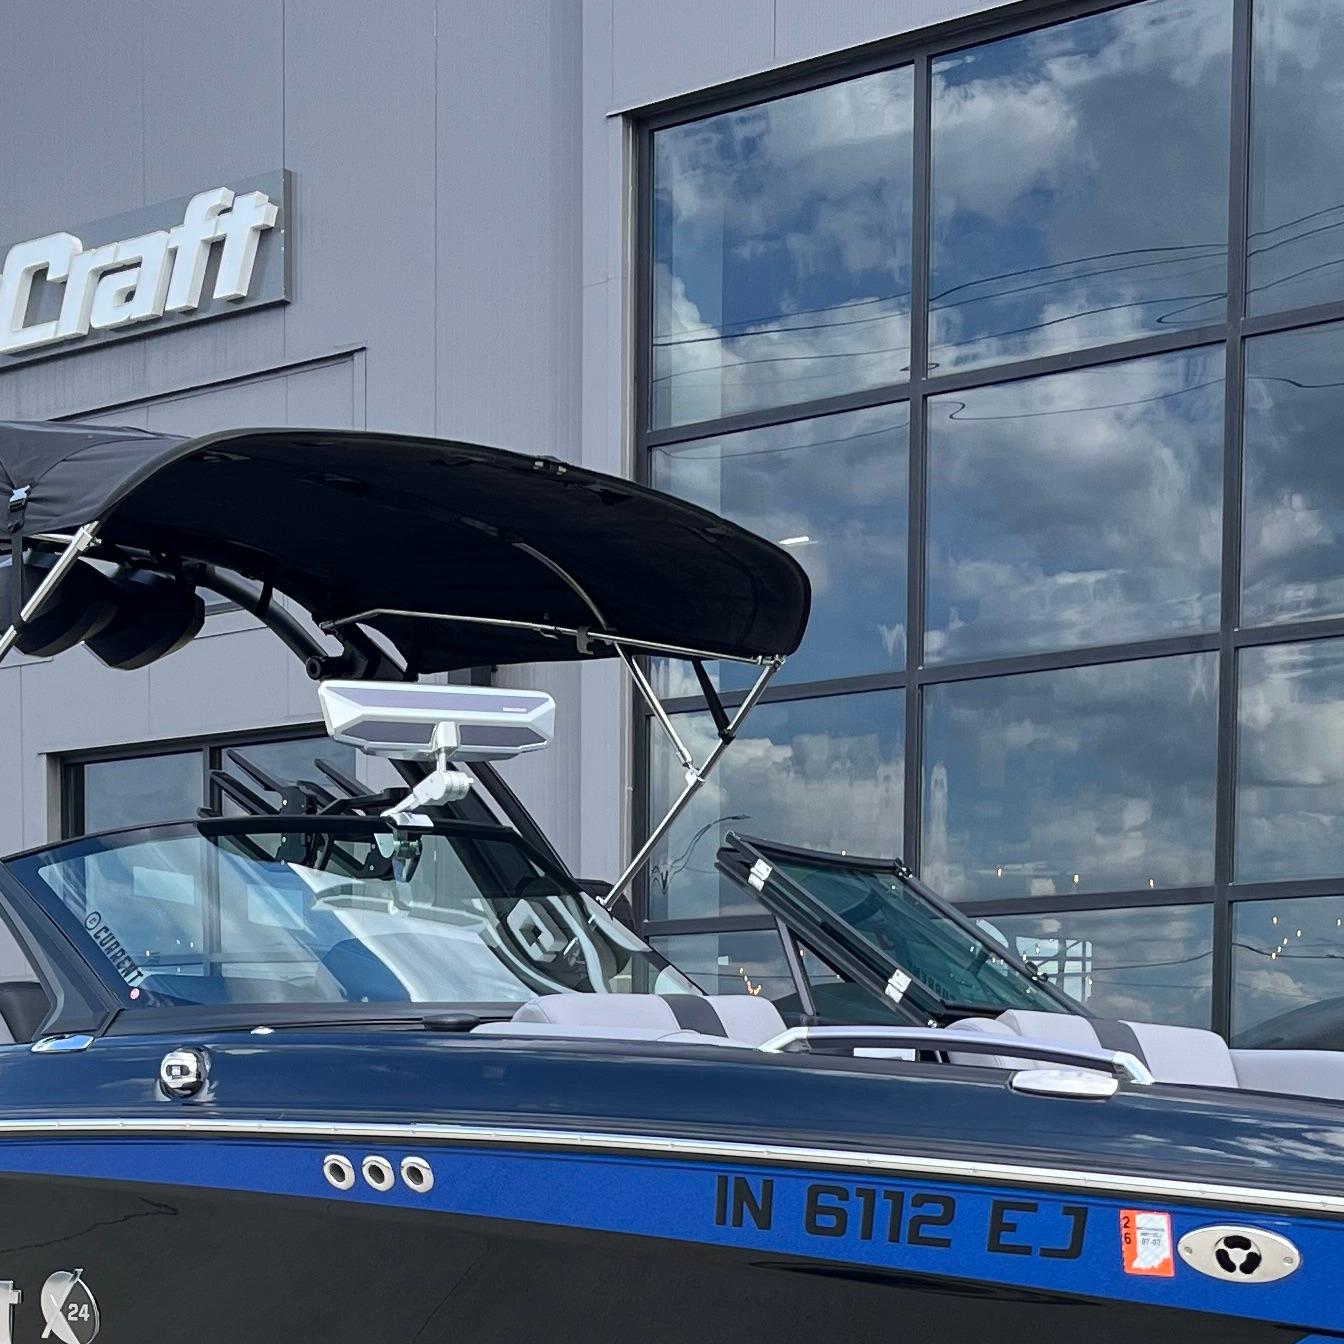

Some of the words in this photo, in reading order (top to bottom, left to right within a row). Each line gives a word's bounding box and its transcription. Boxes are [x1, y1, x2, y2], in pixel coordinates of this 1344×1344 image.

[93, 926, 143, 985] CURRENT
[715, 1175, 774, 1230] IN
[806, 1184, 957, 1248] 6112
[987, 1200, 1089, 1260] EJ
